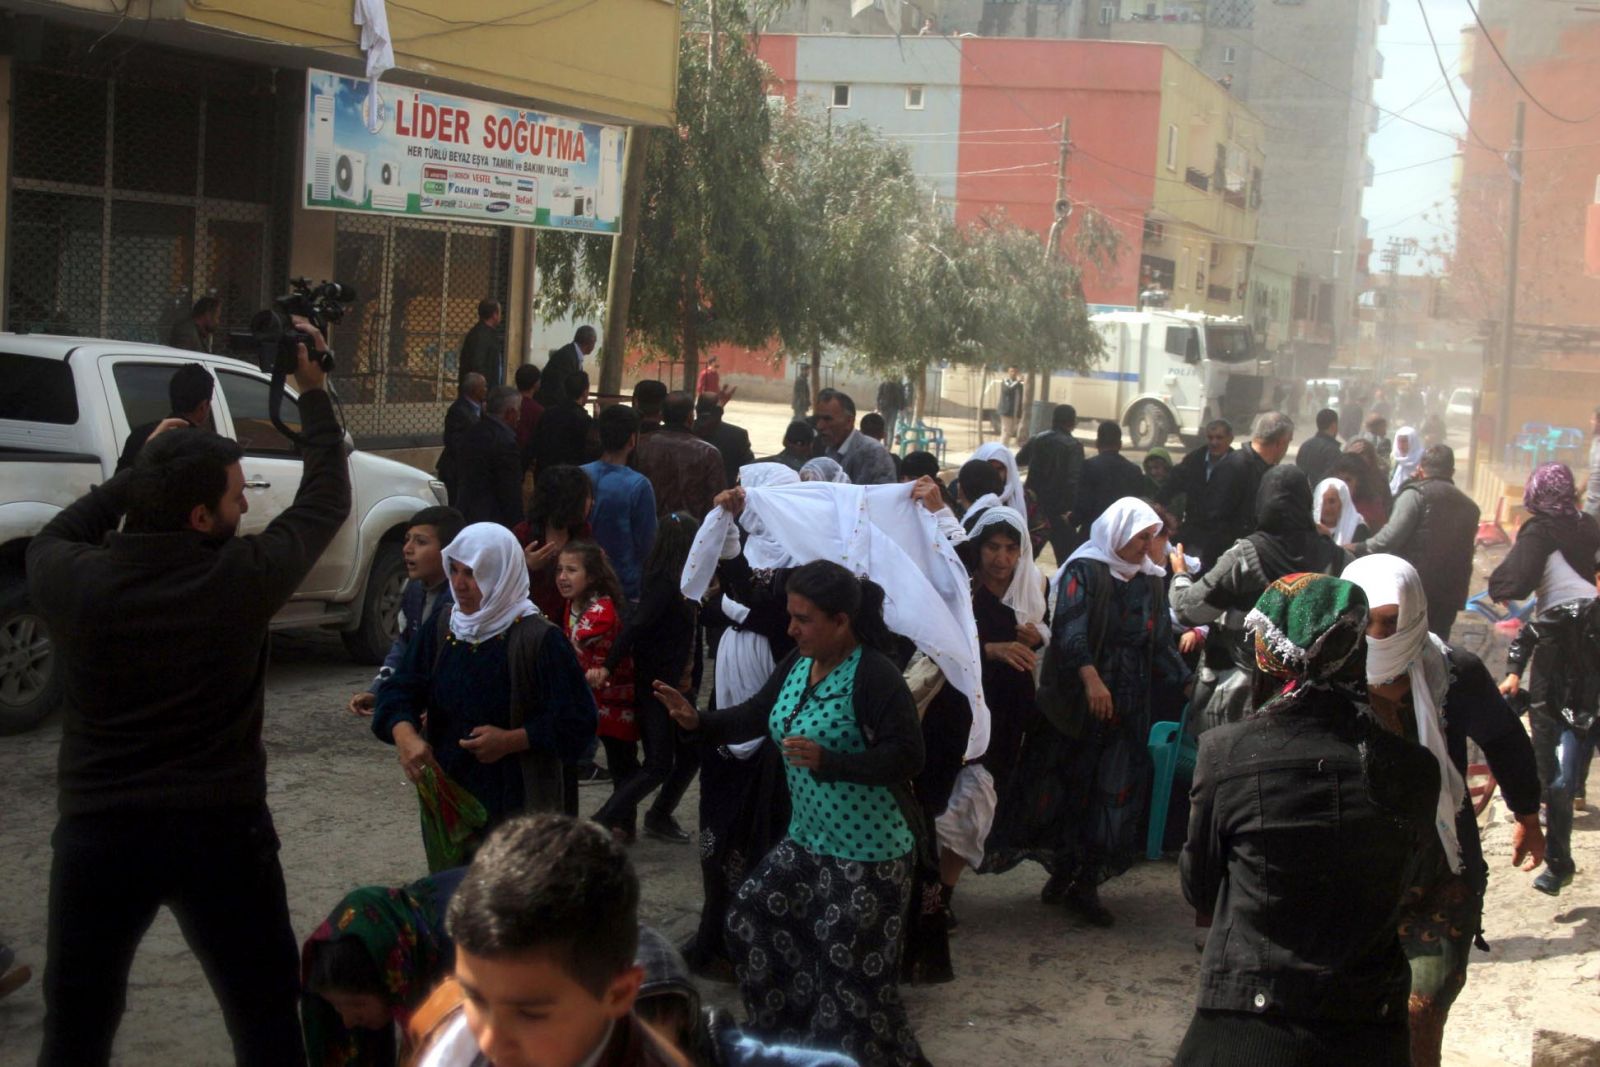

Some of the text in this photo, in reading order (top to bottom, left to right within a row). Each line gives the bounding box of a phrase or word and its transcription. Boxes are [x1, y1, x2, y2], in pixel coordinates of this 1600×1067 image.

[395, 93, 586, 163] LİDER SOĞUTMA
[407, 145, 422, 158] HER
[424, 147, 447, 161] TÜRLÜ
[449, 151, 471, 164] BEYAZ
[472, 154, 489, 167] EŞYA
[515, 163, 522, 171] ve
[523, 161, 546, 174] BAKIMI
[546, 164, 569, 177] YAPILIR
[472, 174, 491, 184] VESTEL
[454, 185, 479, 196] DAIKIN
[515, 195, 533, 205] Tefal
